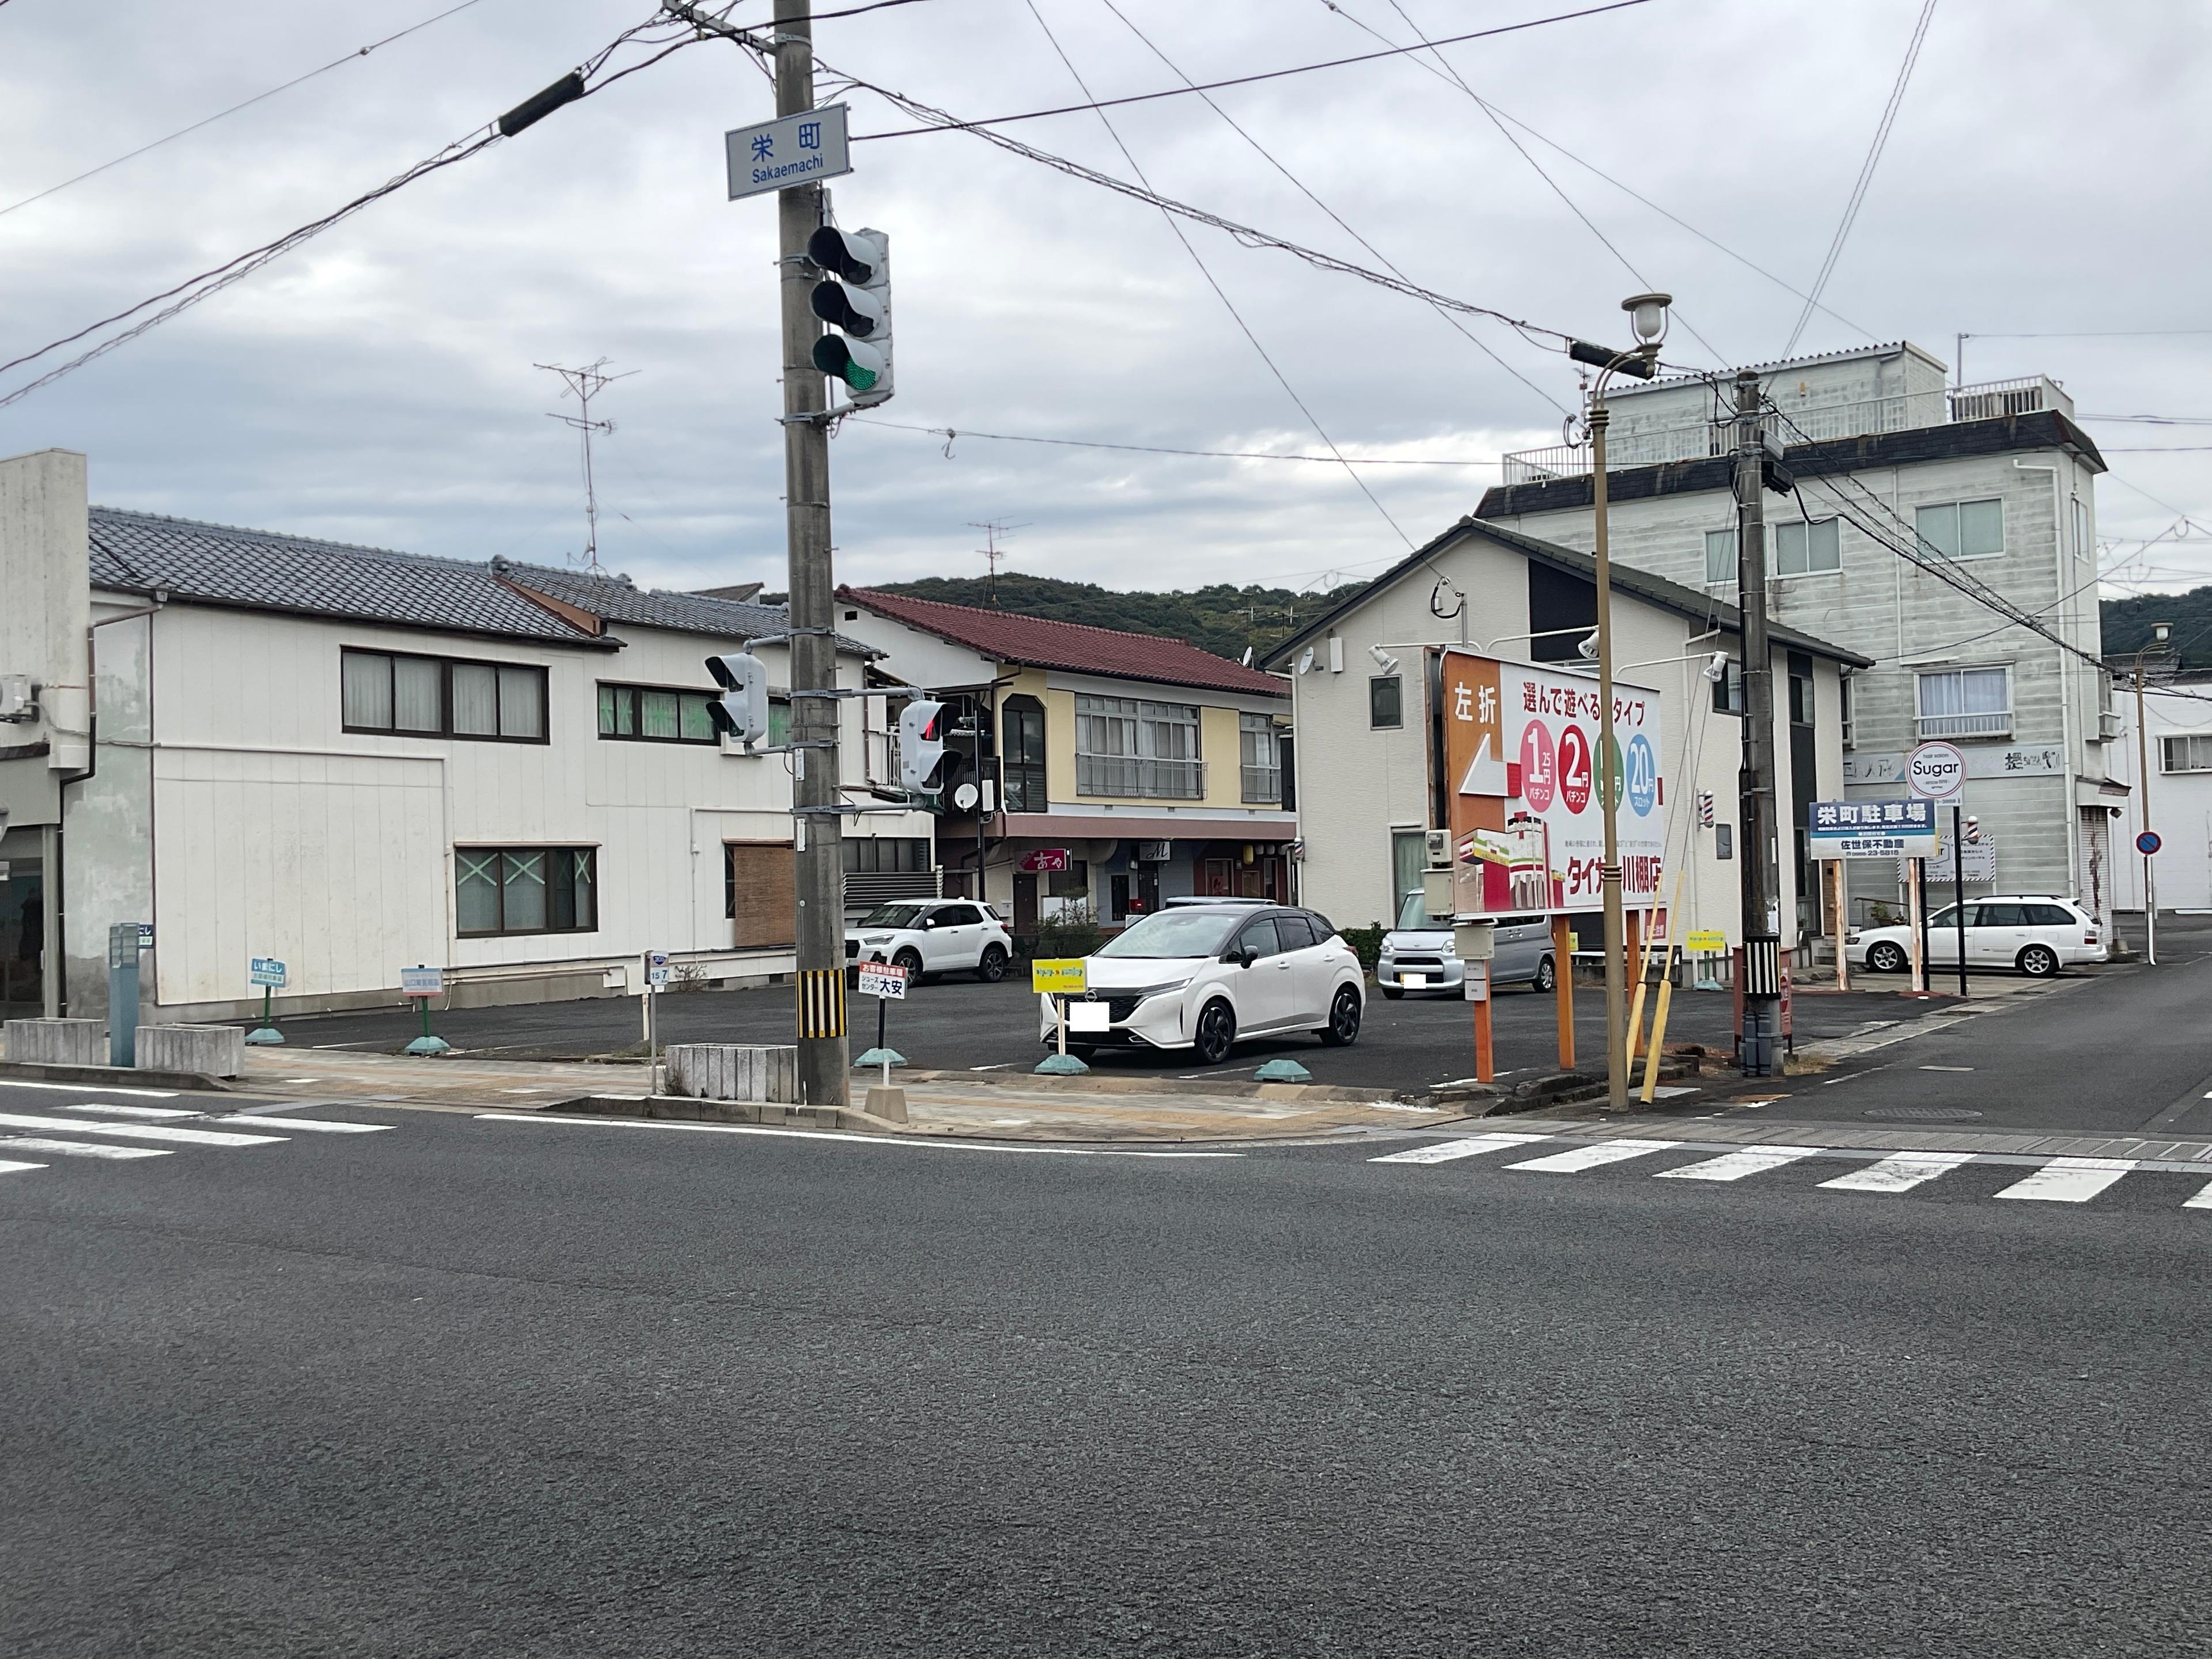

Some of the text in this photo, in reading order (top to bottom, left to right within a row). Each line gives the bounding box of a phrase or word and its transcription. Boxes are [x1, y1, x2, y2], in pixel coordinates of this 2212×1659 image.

[752, 122, 821, 162] 栄町
[752, 153, 823, 183] Sakaemachi
[1455, 681, 1496, 724] 左折
[1523, 681, 1645, 727] 選んで遊べるタイプ
[1913, 760, 1959, 777] Sugar
[1529, 787, 1550, 800] パチンコ
[1566, 790, 1585, 803] パチンコ
[1817, 803, 1927, 825] 栄町駐車場
[1146, 842, 1168, 859] M
[1841, 839, 1904, 850] 佐世保不動産
[1033, 851, 1063, 870] あや
[254, 961, 283, 972] いまにし
[862, 975, 879, 983] シューズ
[880, 978, 903, 995] 大安
